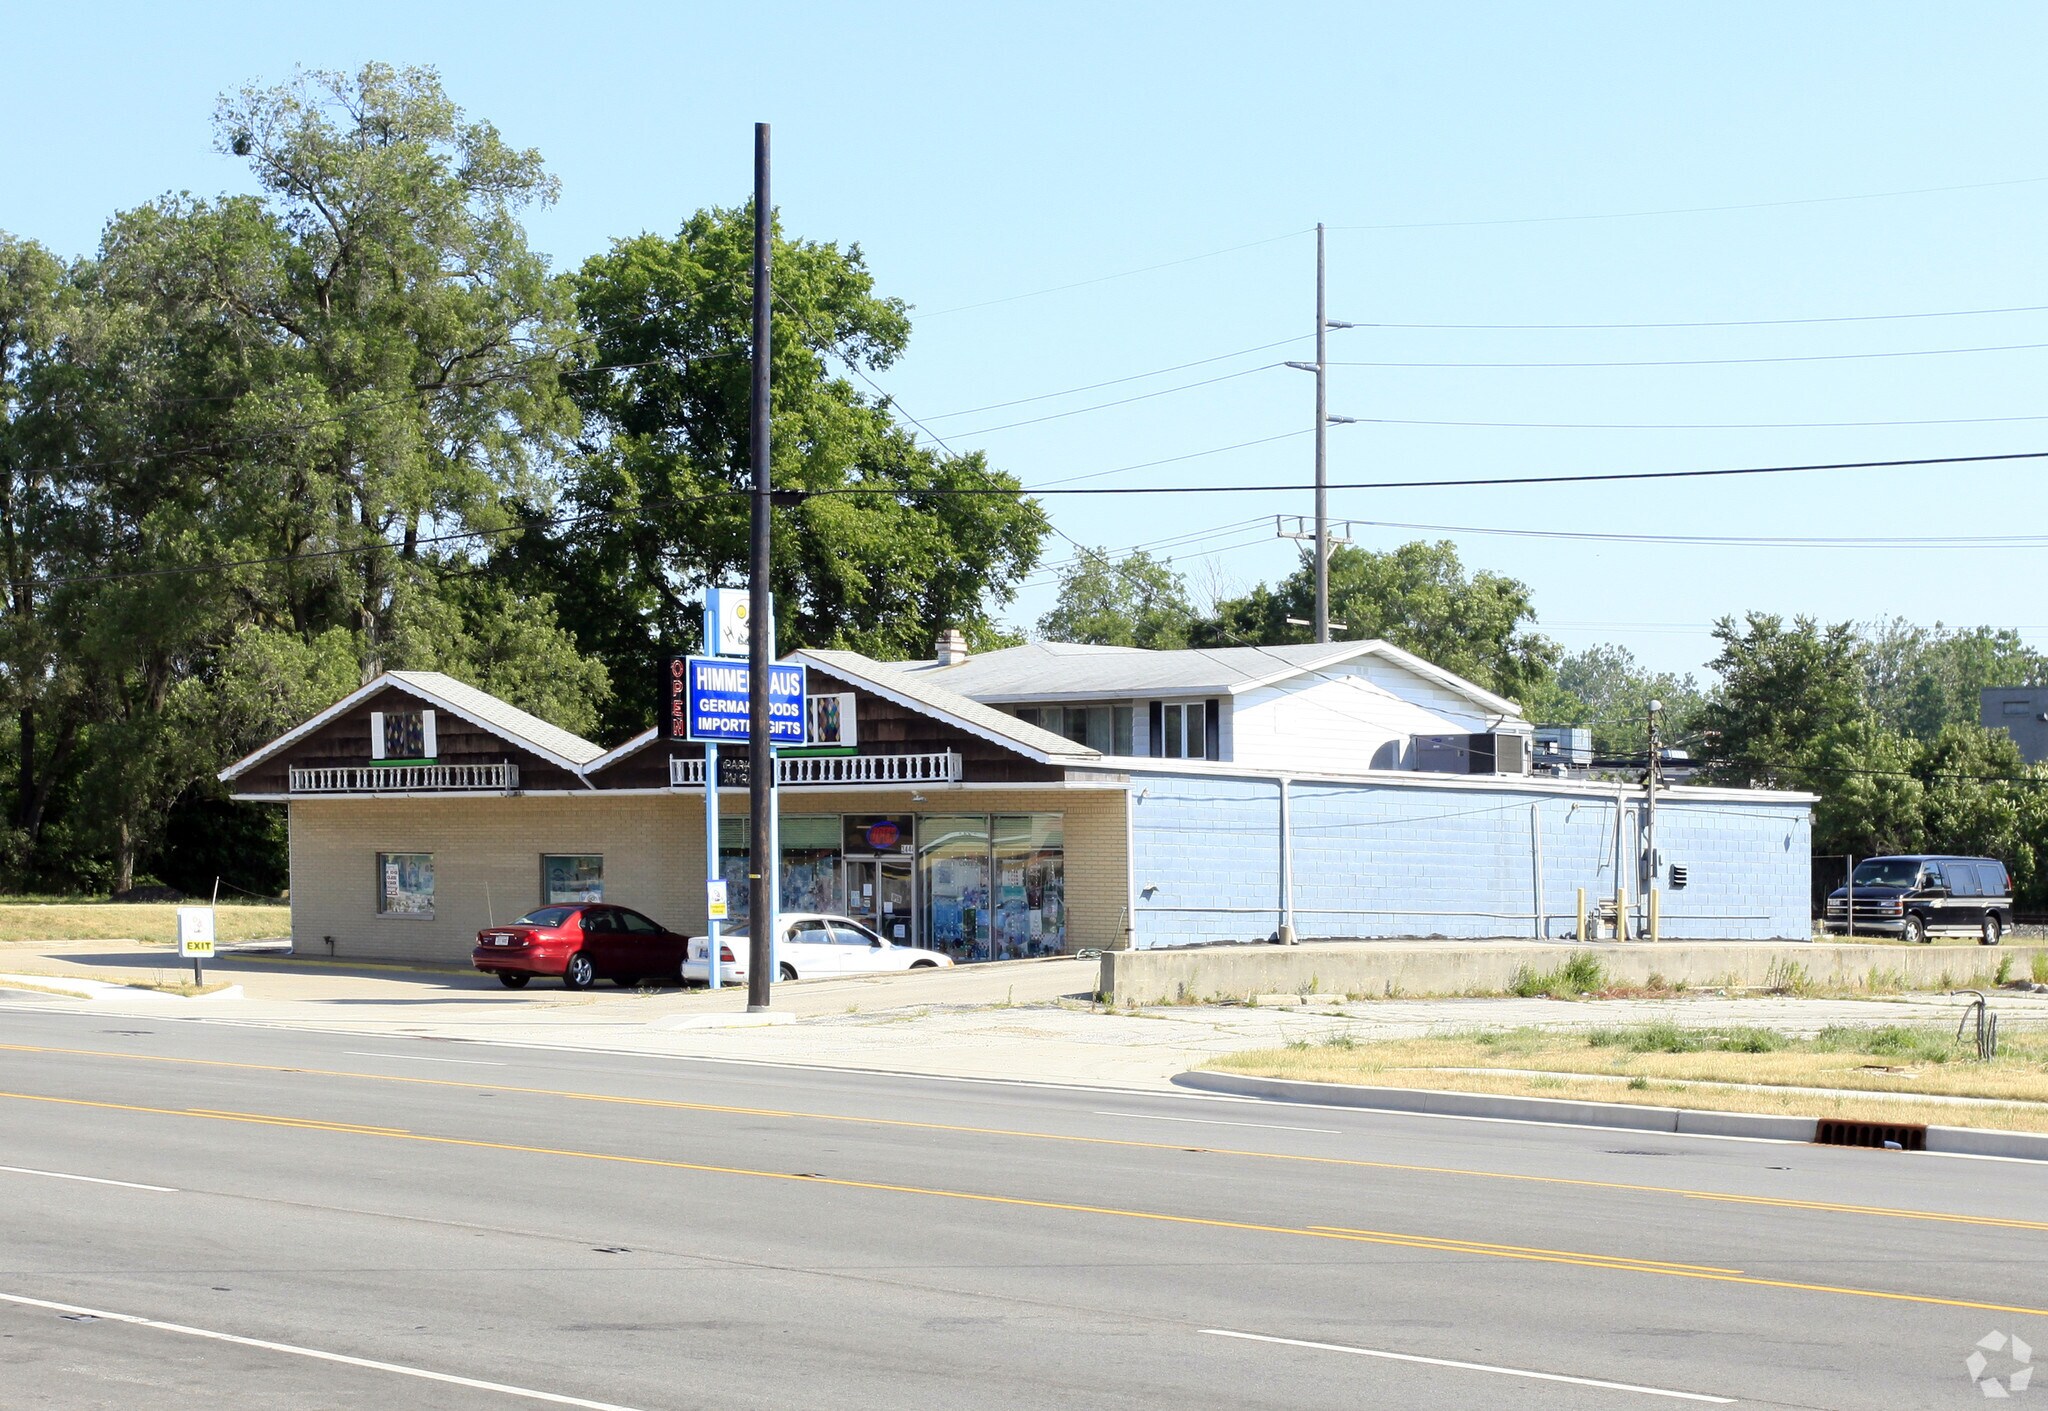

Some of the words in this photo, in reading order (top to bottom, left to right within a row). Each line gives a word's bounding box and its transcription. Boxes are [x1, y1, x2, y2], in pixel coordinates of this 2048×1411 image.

[697, 666, 749, 693] HIMME
[769, 672, 801, 697] AUS
[671, 660, 684, 736] OPEN
[699, 698, 749, 714] GERMA
[698, 716, 749, 732] IMPORT
[769, 720, 801, 735] GIFTS
[187, 942, 211, 950] EXIT
